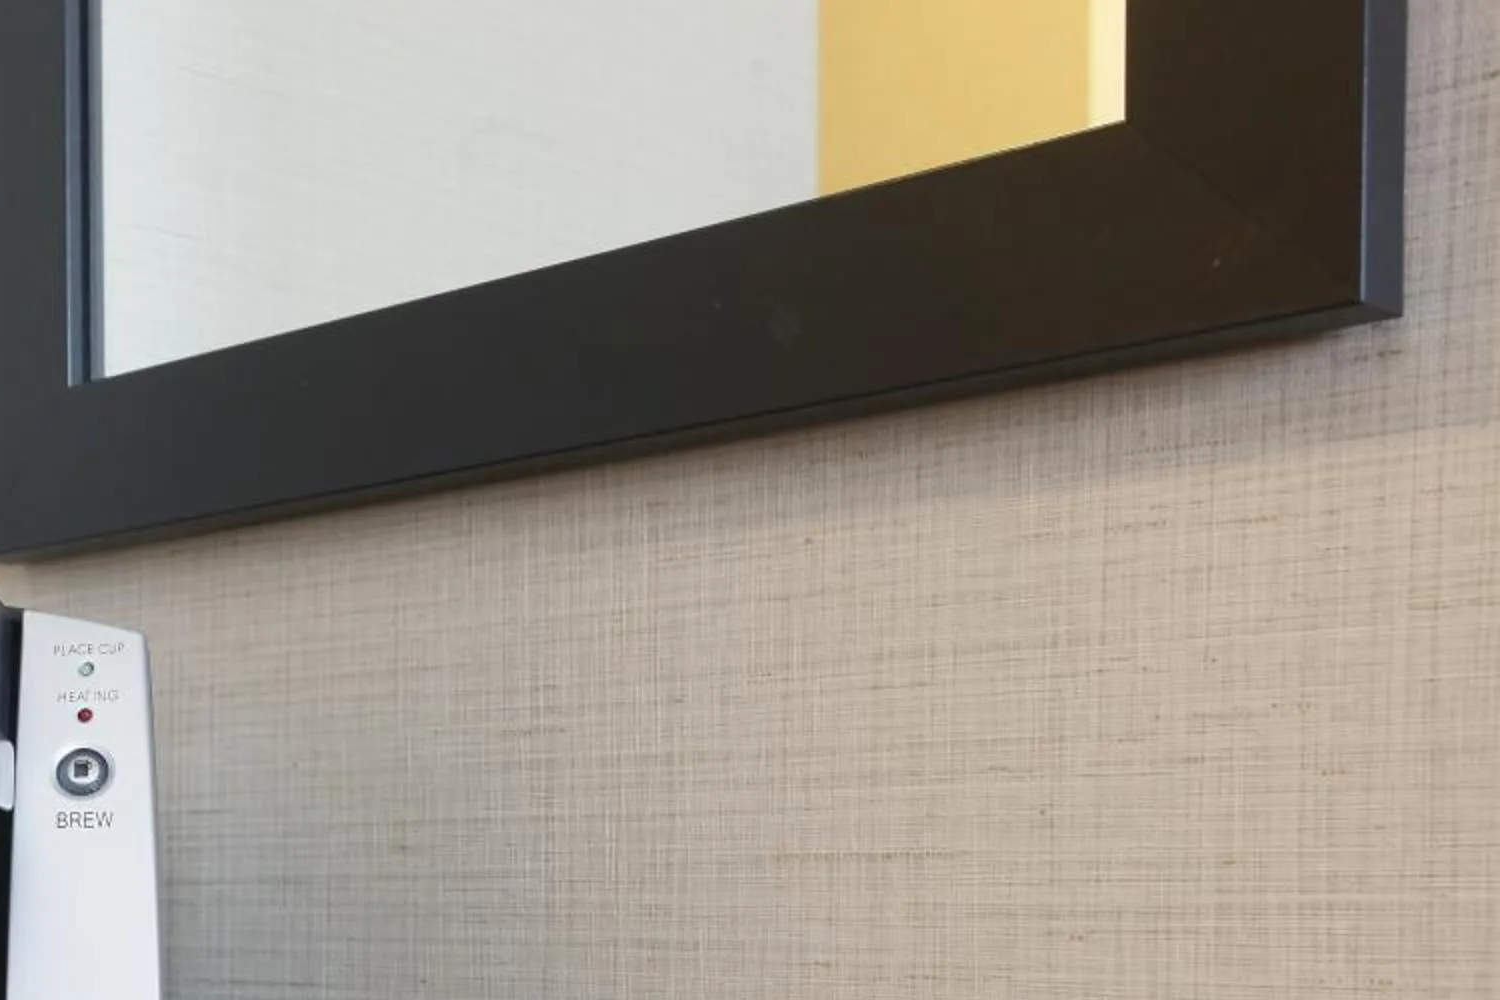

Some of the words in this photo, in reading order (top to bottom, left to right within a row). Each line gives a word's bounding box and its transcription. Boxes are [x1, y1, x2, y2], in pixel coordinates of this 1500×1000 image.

[98, 641, 124, 655] CUP
[56, 689, 120, 703] HEATING
[56, 811, 113, 829] BREW
